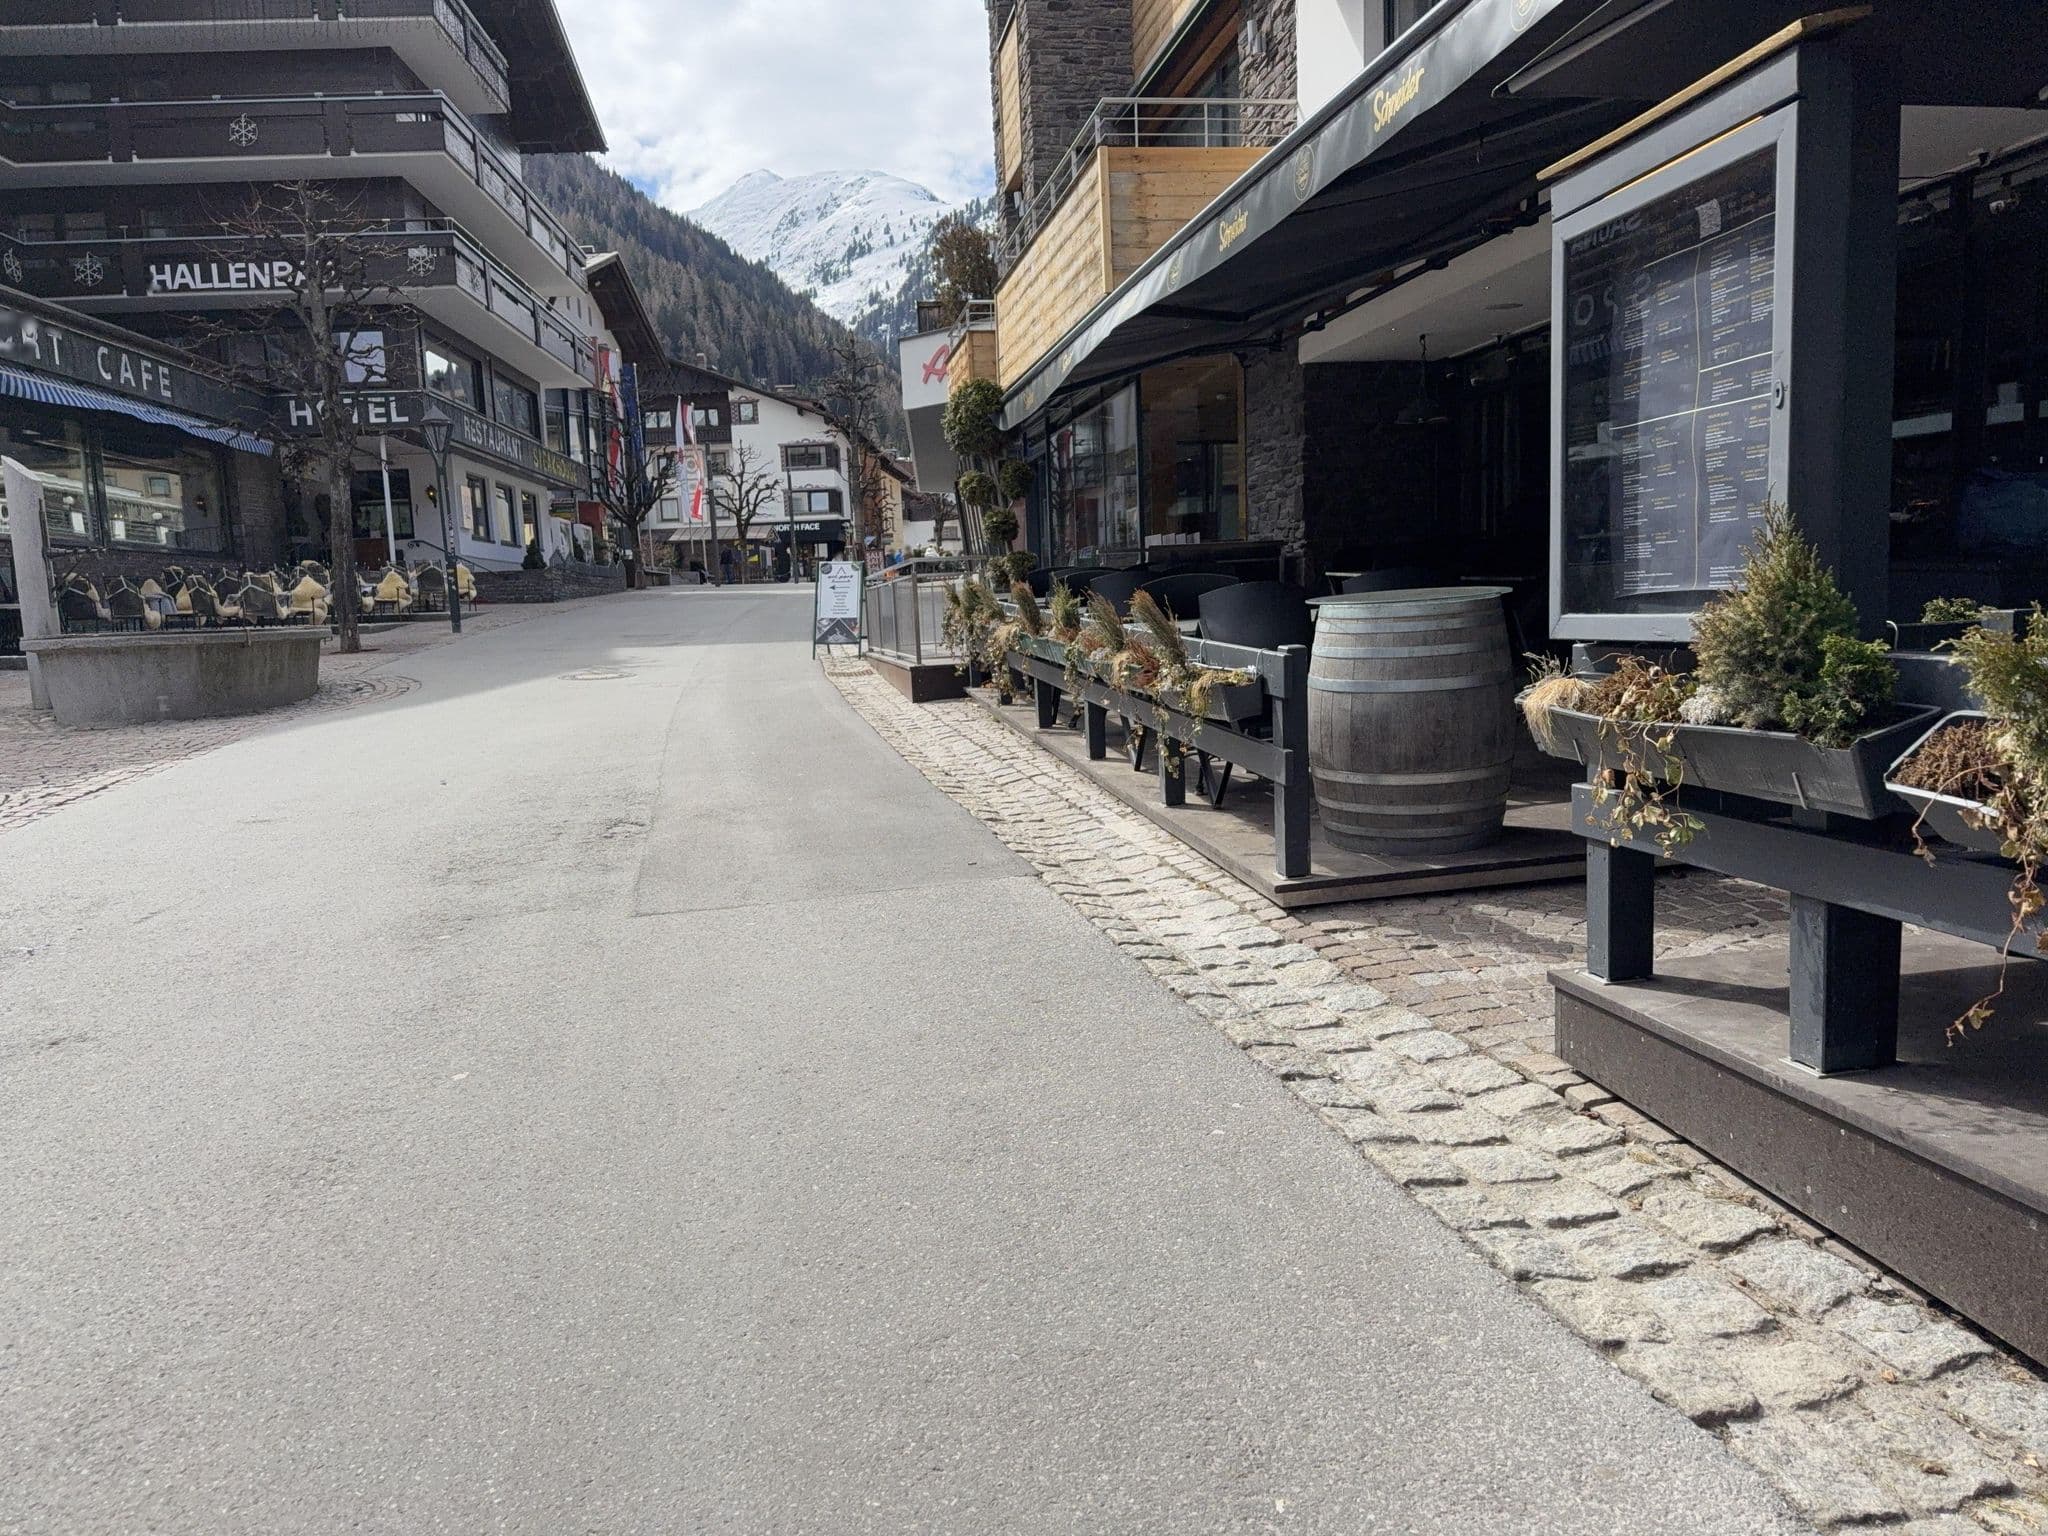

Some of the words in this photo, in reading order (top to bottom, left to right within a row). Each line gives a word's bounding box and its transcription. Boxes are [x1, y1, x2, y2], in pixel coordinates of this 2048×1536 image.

[97, 346, 172, 398] CAFE
[463, 414, 522, 461] RESTAURANT
[800, 522, 820, 531] FACE
